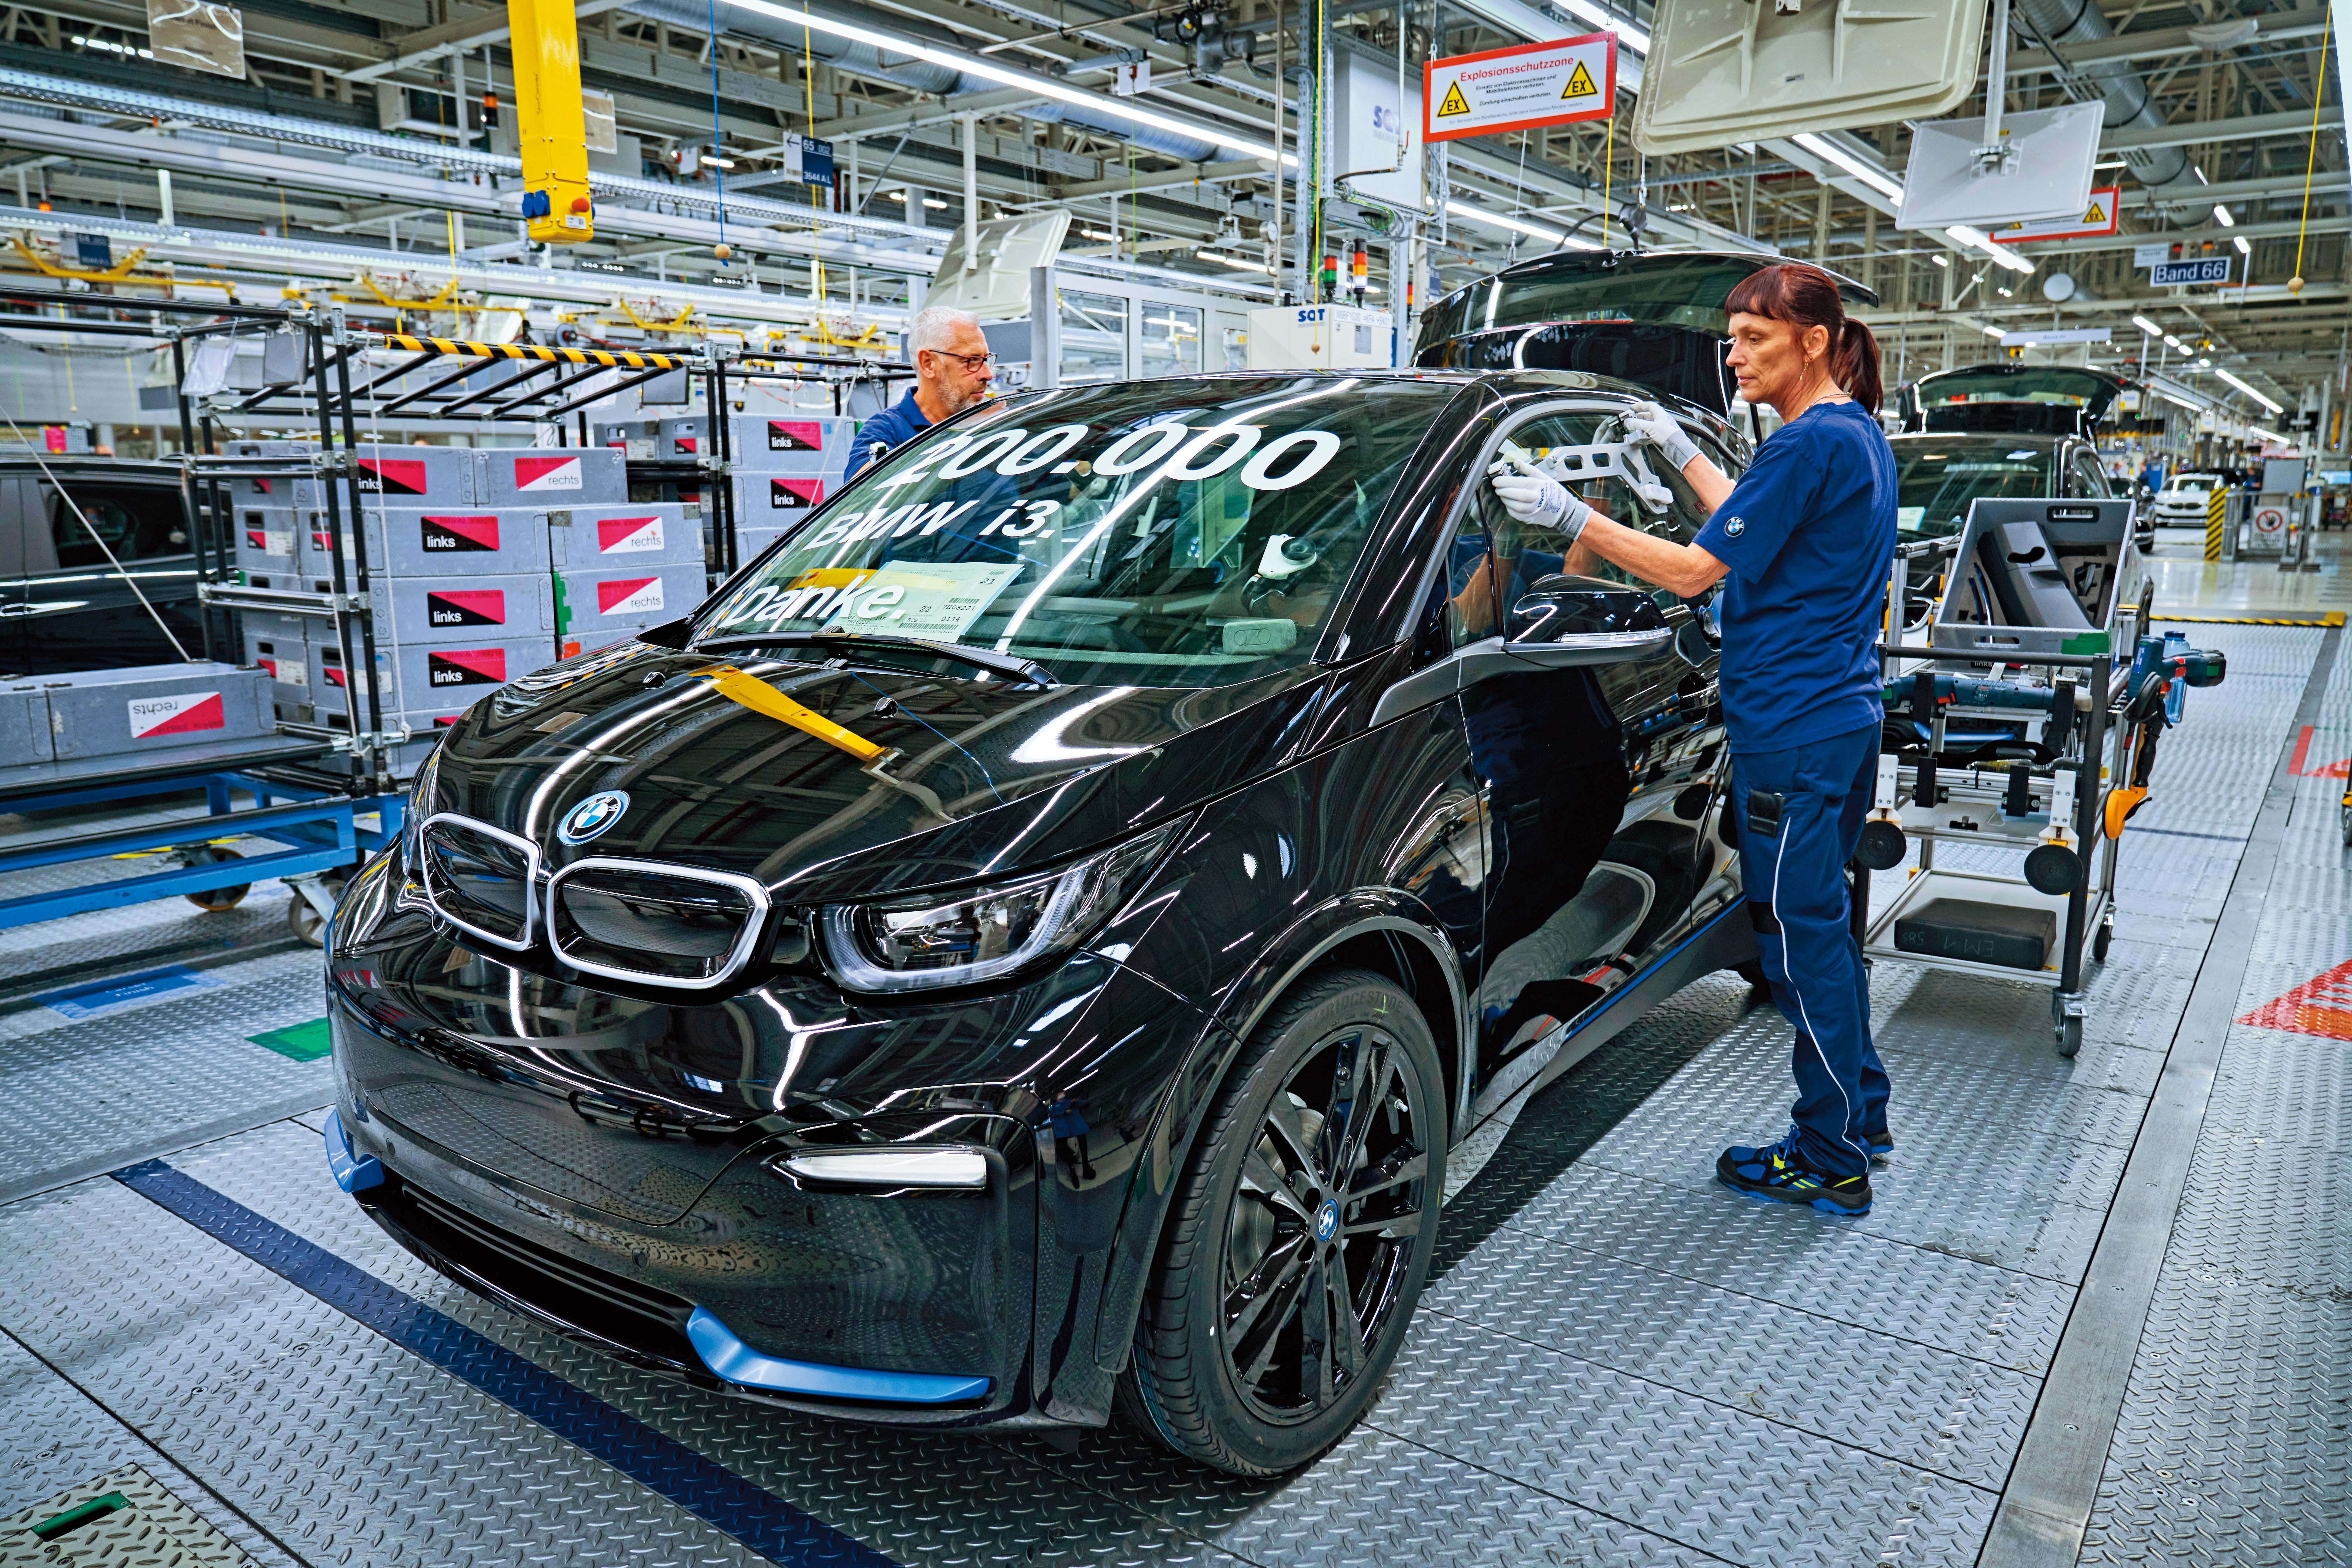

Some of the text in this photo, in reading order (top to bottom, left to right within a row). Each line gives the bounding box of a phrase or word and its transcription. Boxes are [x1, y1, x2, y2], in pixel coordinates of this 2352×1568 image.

[1460, 58, 1574, 82] Explosionsschutzzone
[1503, 76, 1546, 87] Elektromaschinen
[1572, 79, 1586, 93] EX
[1486, 85, 1522, 94] Mobiltelefonen
[1501, 95, 1528, 103] einschalten
[1447, 99, 1460, 112] EX
[802, 139, 815, 151] 65
[2156, 261, 2224, 282] Band 66
[772, 437, 792, 448] links
[872, 422, 1341, 491] 200.000
[358, 477, 383, 489] inks
[549, 475, 579, 485] rechts
[774, 495, 794, 505] links
[801, 499, 1061, 551] BMW i3.
[427, 535, 456, 548] links
[631, 535, 661, 547] rechts
[631, 596, 661, 607] rechts
[717, 575, 907, 628] Danke.
[434, 610, 462, 623] links
[434, 671, 462, 683] links
[134, 701, 178, 715] rechts
[1808, 1173, 1824, 1182] atlas
